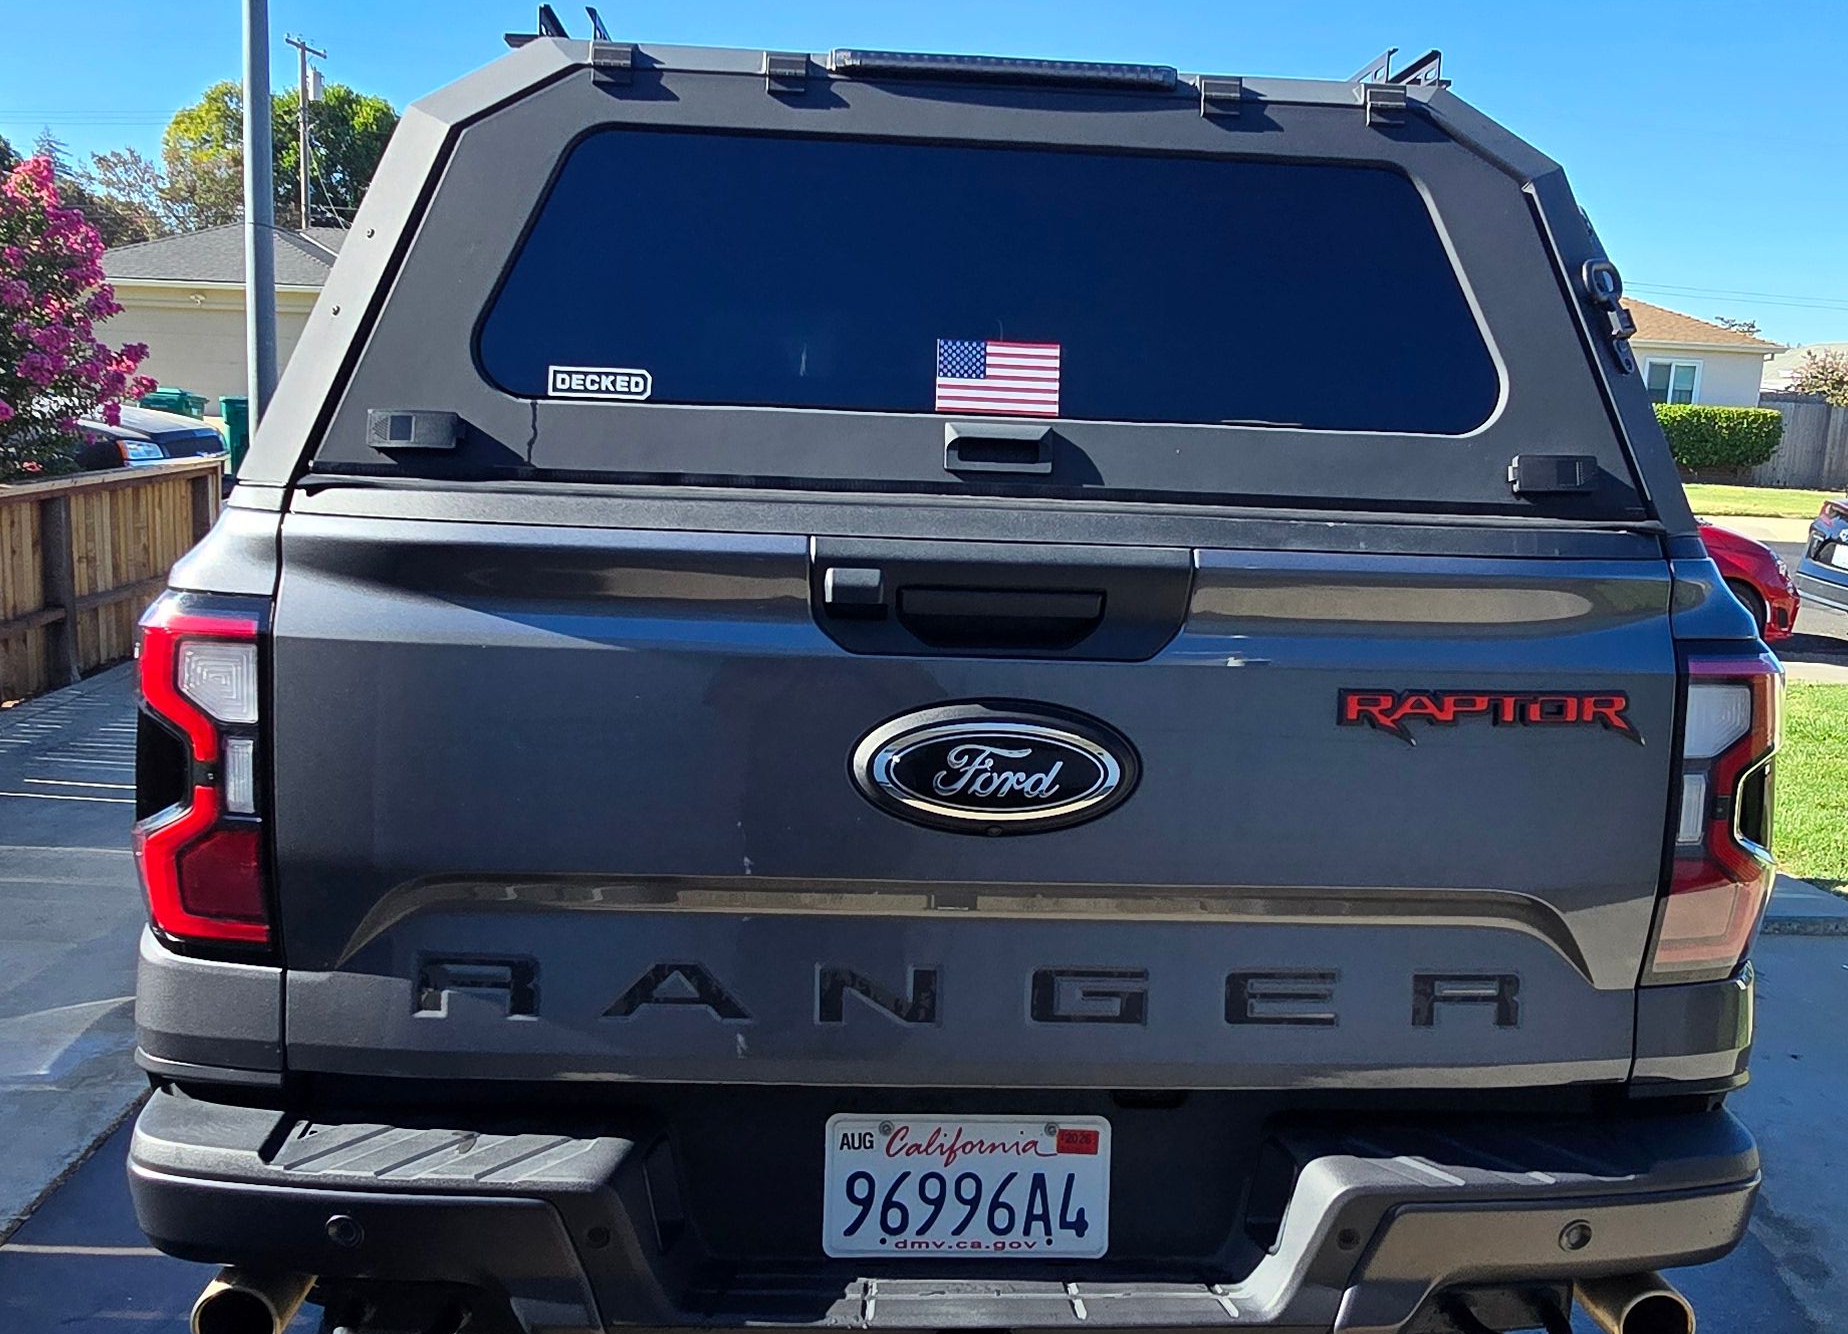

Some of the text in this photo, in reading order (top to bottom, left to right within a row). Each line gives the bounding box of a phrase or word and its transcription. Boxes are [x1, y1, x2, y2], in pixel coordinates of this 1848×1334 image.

[555, 373, 645, 393] DECKED
[1338, 689, 1644, 747] RAPTOR
[933, 743, 1062, 802] Ford
[409, 953, 1524, 1029] RANGER
[839, 1132, 874, 1151] AUG
[885, 1125, 1058, 1167] California
[843, 1170, 1089, 1238] 96996A4
[894, 1238, 1037, 1252] dmv.ca.gov
